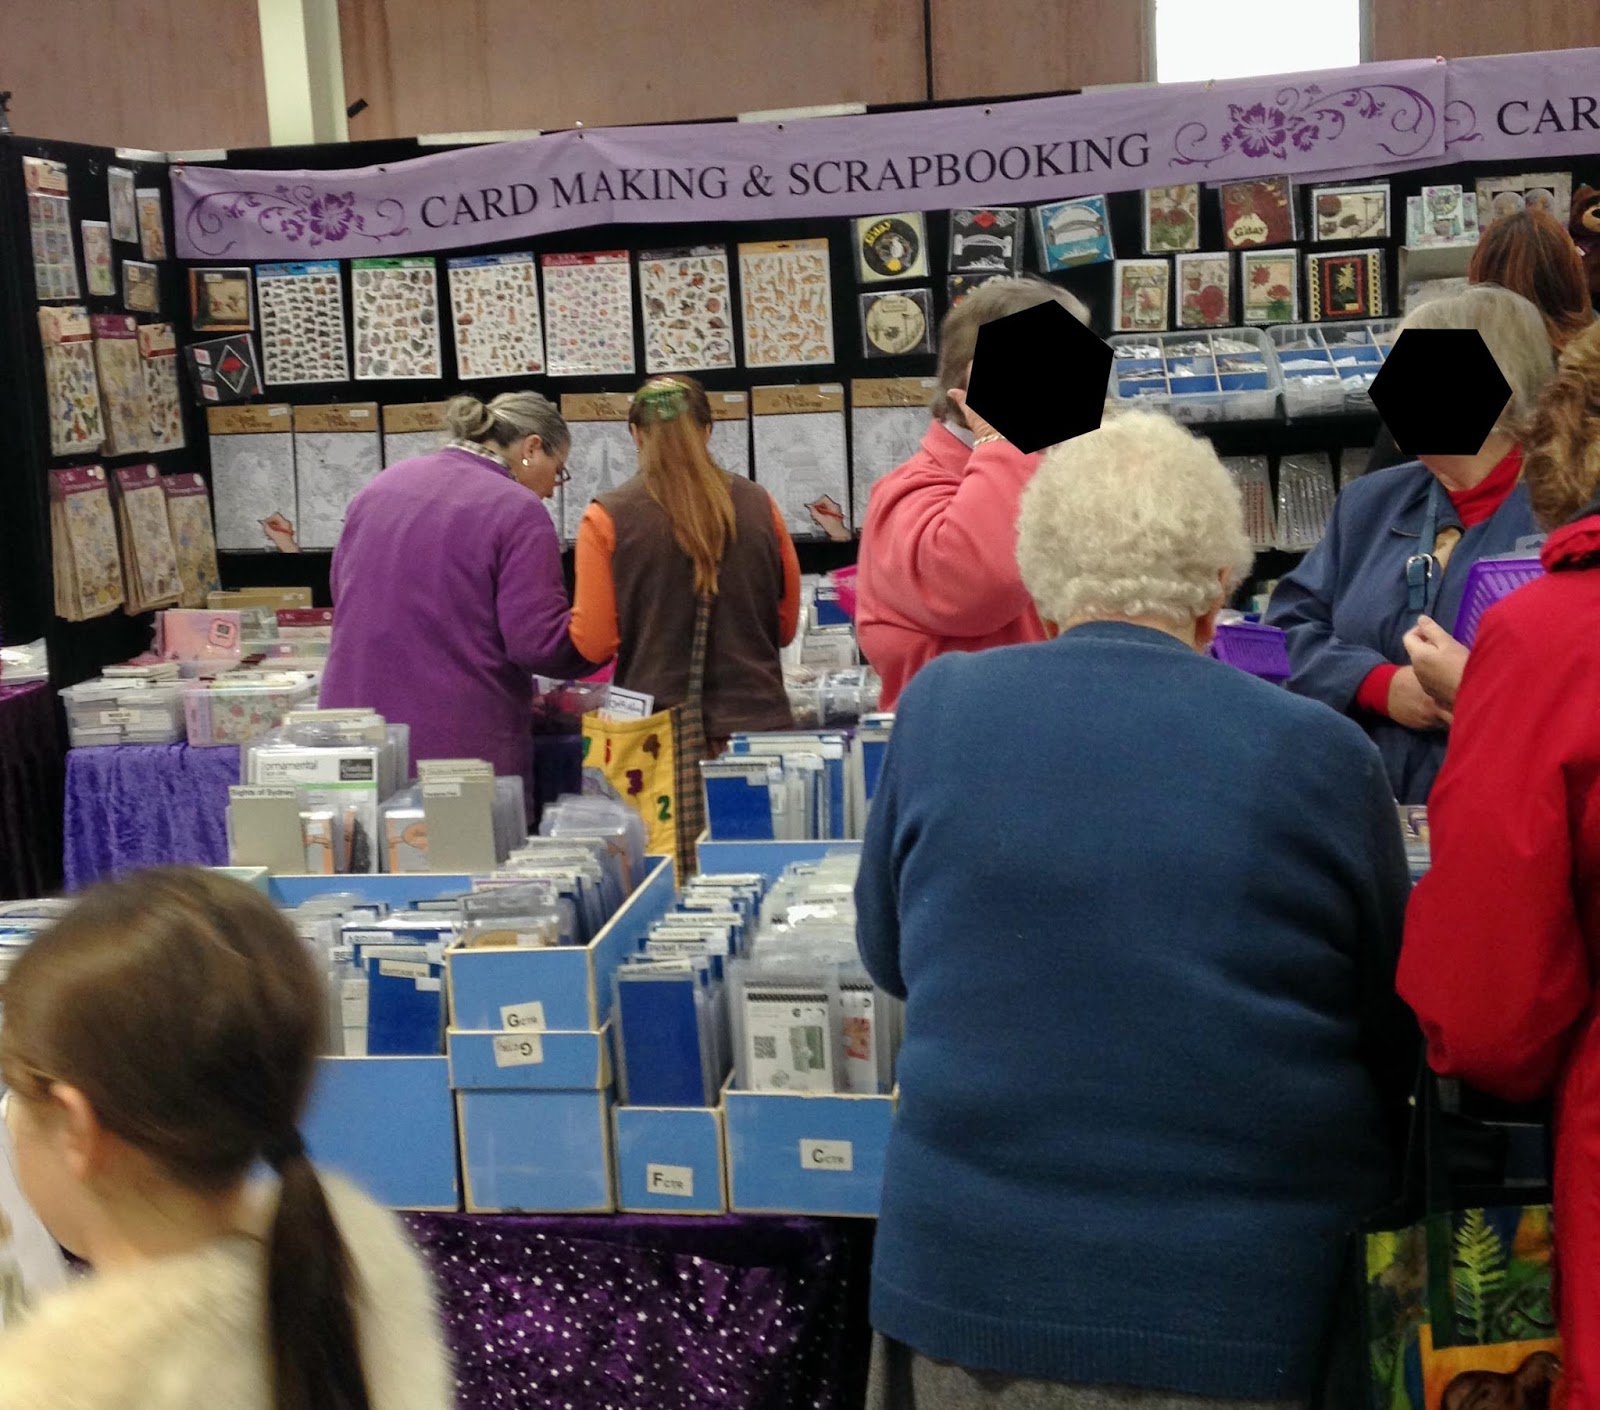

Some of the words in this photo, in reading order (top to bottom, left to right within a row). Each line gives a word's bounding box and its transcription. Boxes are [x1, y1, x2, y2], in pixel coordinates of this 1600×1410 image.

[420, 183, 540, 229] CARD
[550, 165, 728, 209] MAKING
[742, 165, 775, 199] &
[789, 133, 1150, 197] SCRAPBOOKING
[657, 795, 671, 821] 2
